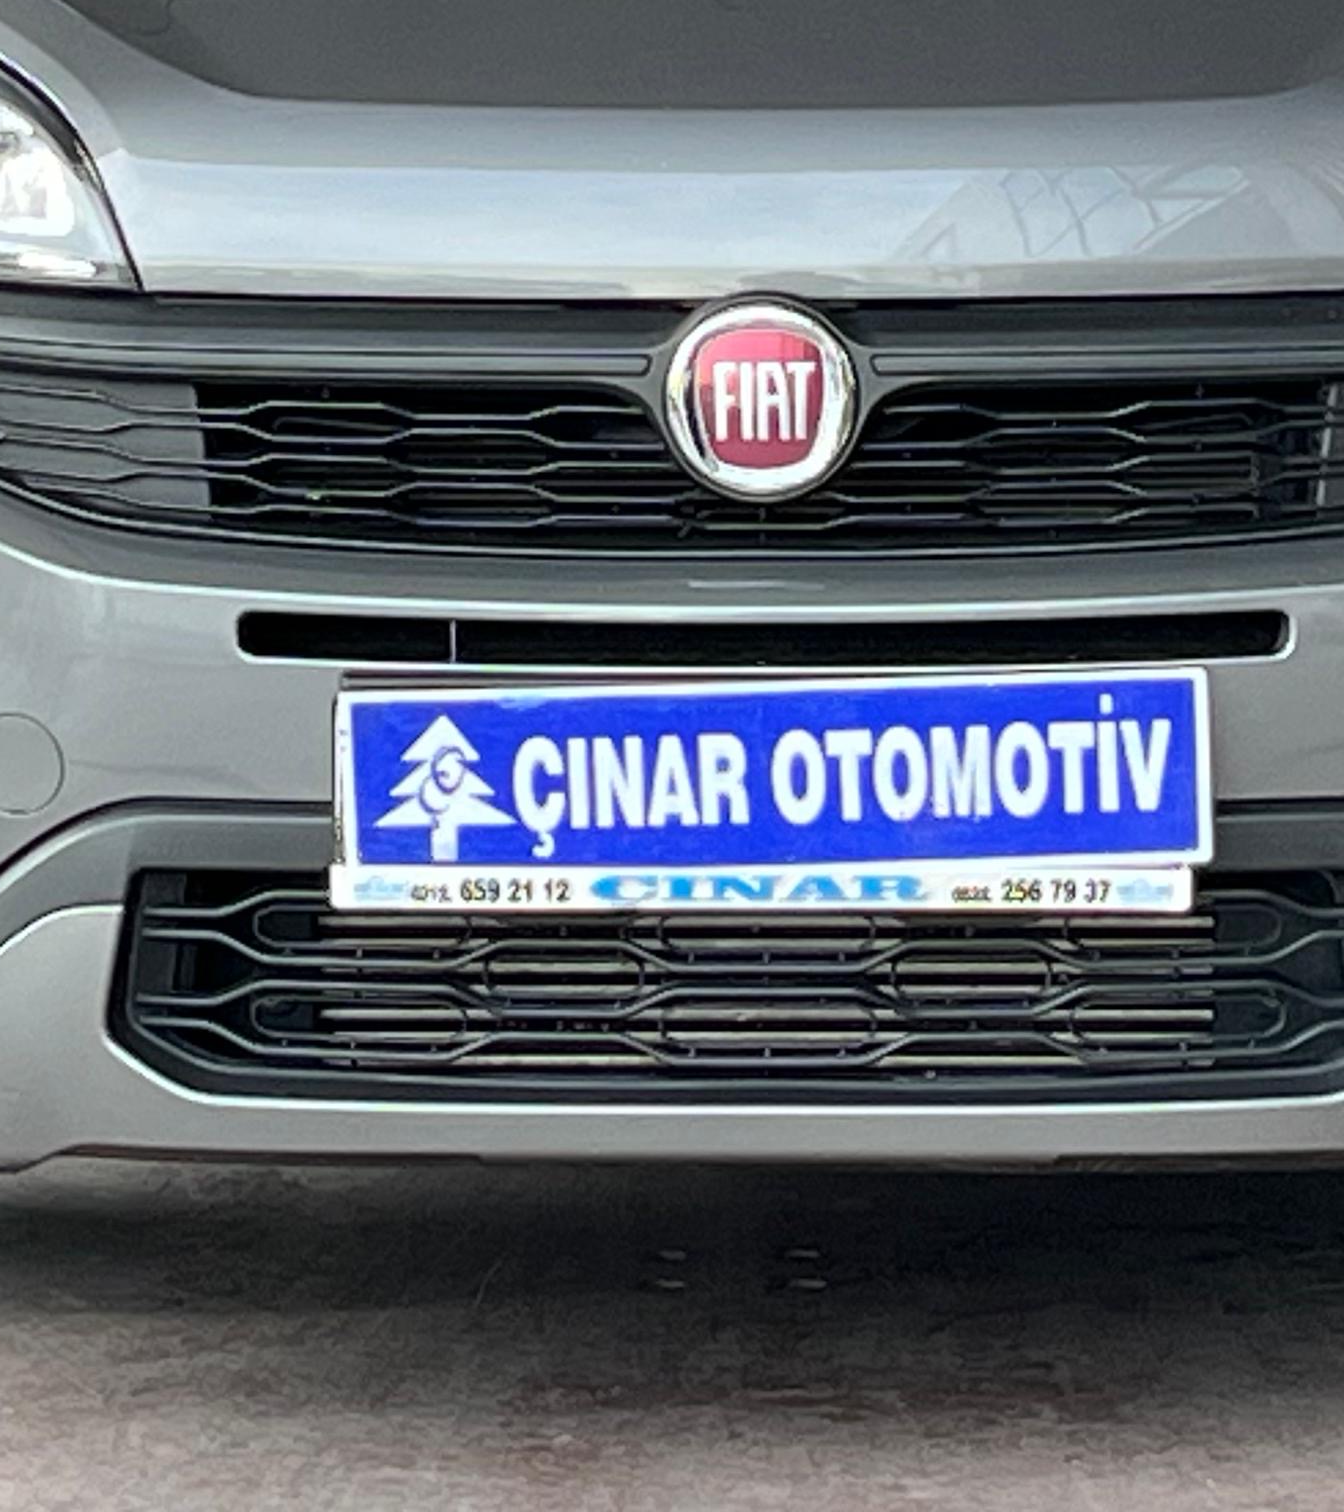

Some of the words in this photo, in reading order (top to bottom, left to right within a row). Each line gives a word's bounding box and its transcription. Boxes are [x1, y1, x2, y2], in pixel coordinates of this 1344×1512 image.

[712, 360, 819, 443] FIAT
[510, 731, 750, 857] ÇINAR
[769, 693, 1172, 826] OTOMOTİV
[459, 877, 501, 903] 659
[506, 877, 534, 903] 21
[543, 877, 571, 903] 12
[1000, 877, 1043, 903] 256
[1049, 877, 1077, 903] 79
[1083, 877, 1112, 903] 37
